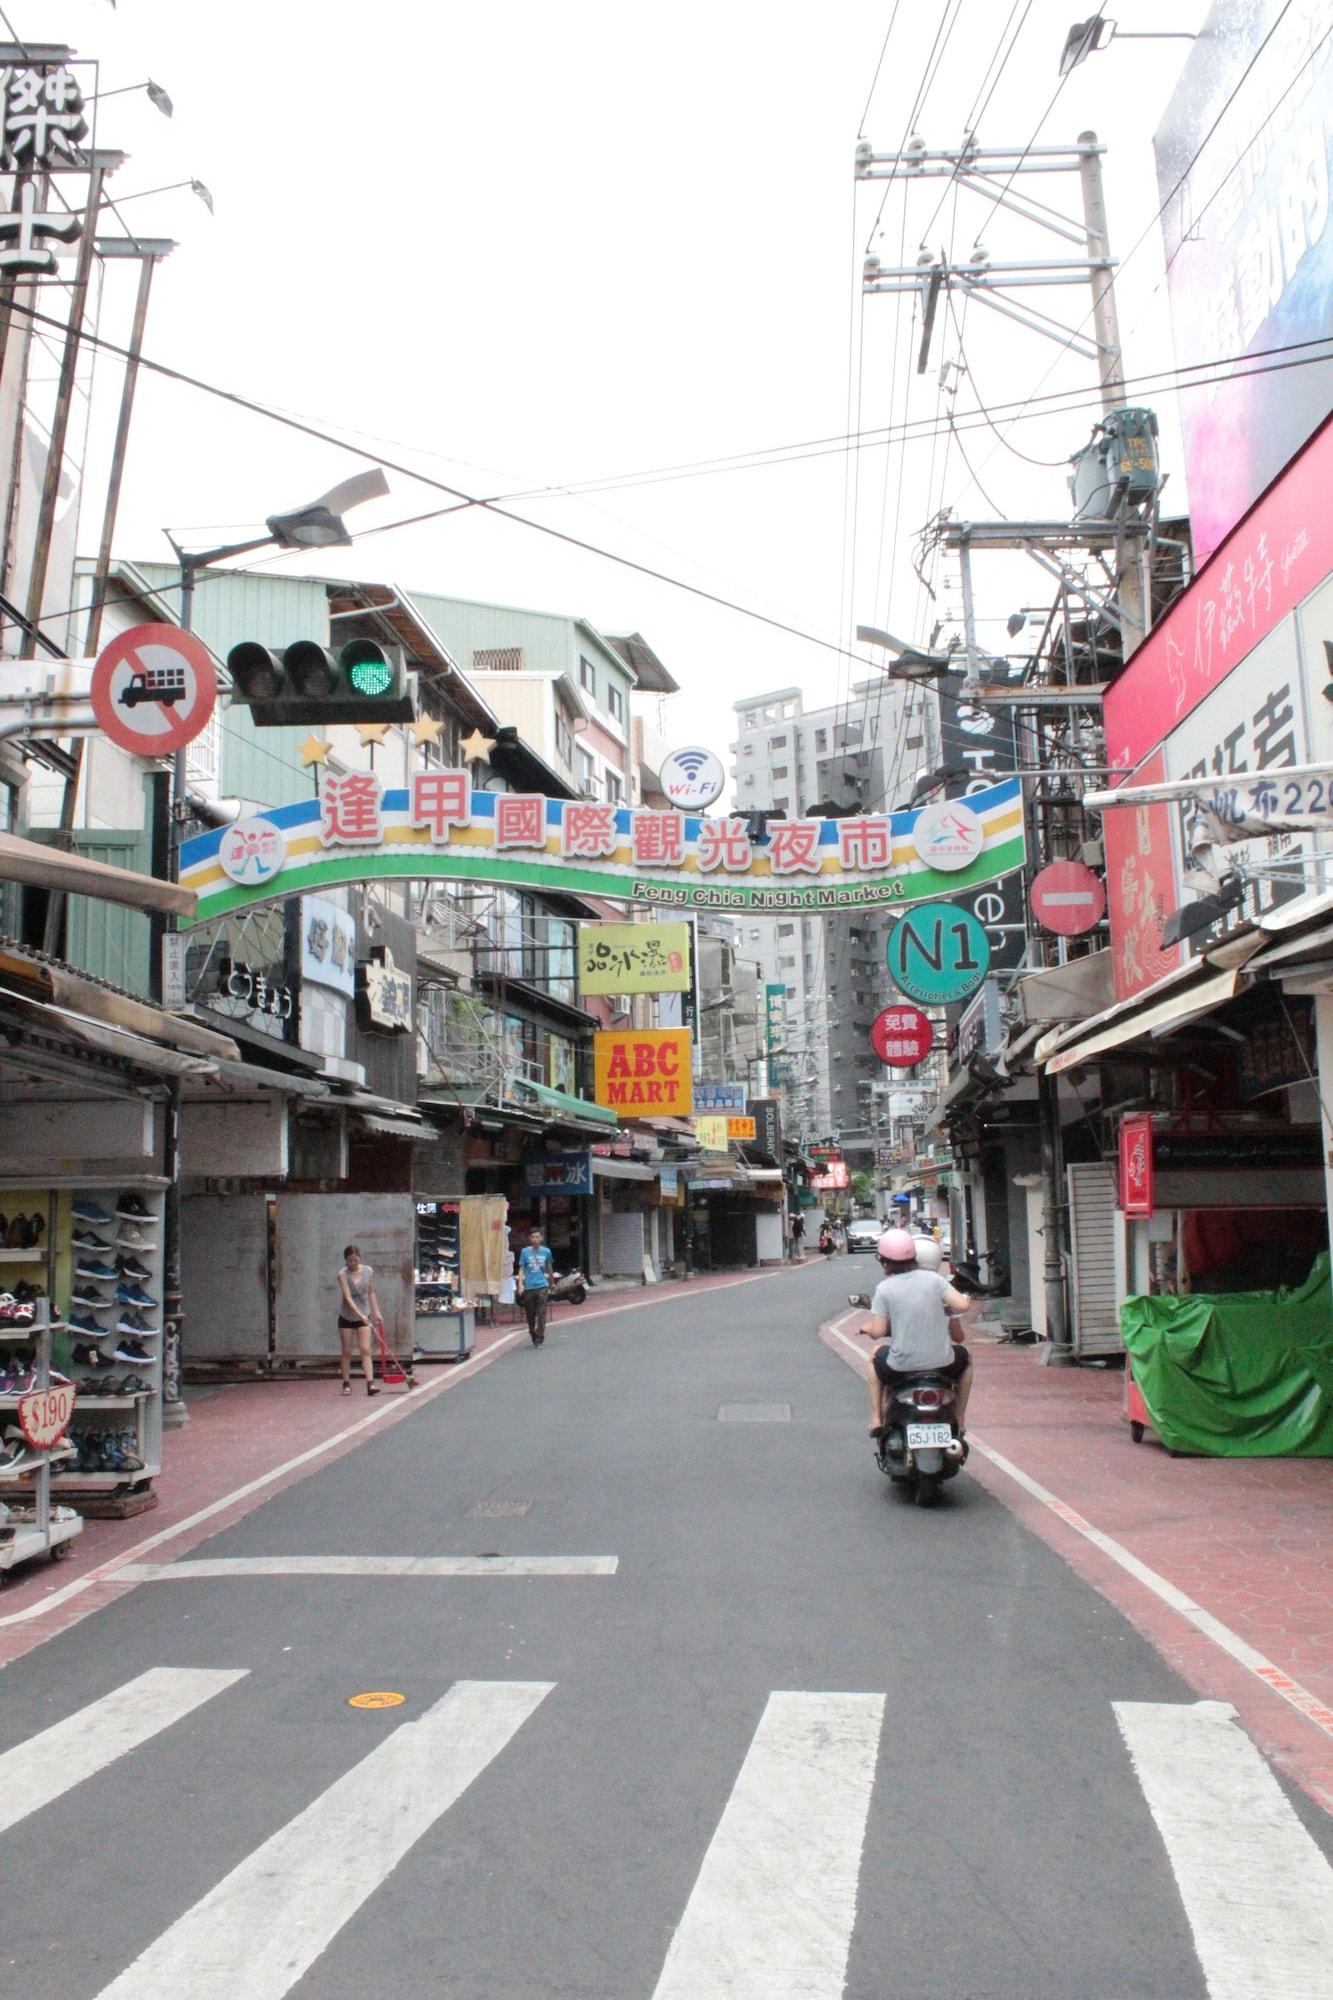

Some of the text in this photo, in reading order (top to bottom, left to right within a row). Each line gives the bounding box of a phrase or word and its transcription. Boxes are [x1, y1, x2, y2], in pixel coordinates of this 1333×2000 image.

[668, 781, 716, 797] Wi-Fi
[323, 773, 890, 873] 逢甲國際觀光夜市
[632, 880, 905, 908] Feng Chia Night Market
[900, 919, 979, 973] N1
[901, 975, 952, 1001] Accessories
[885, 1014, 918, 1031] 免費
[607, 1042, 679, 1079] ABC
[886, 1040, 920, 1057] 體驗
[607, 1081, 680, 1105] MART
[31, 1391, 68, 1433] $190
